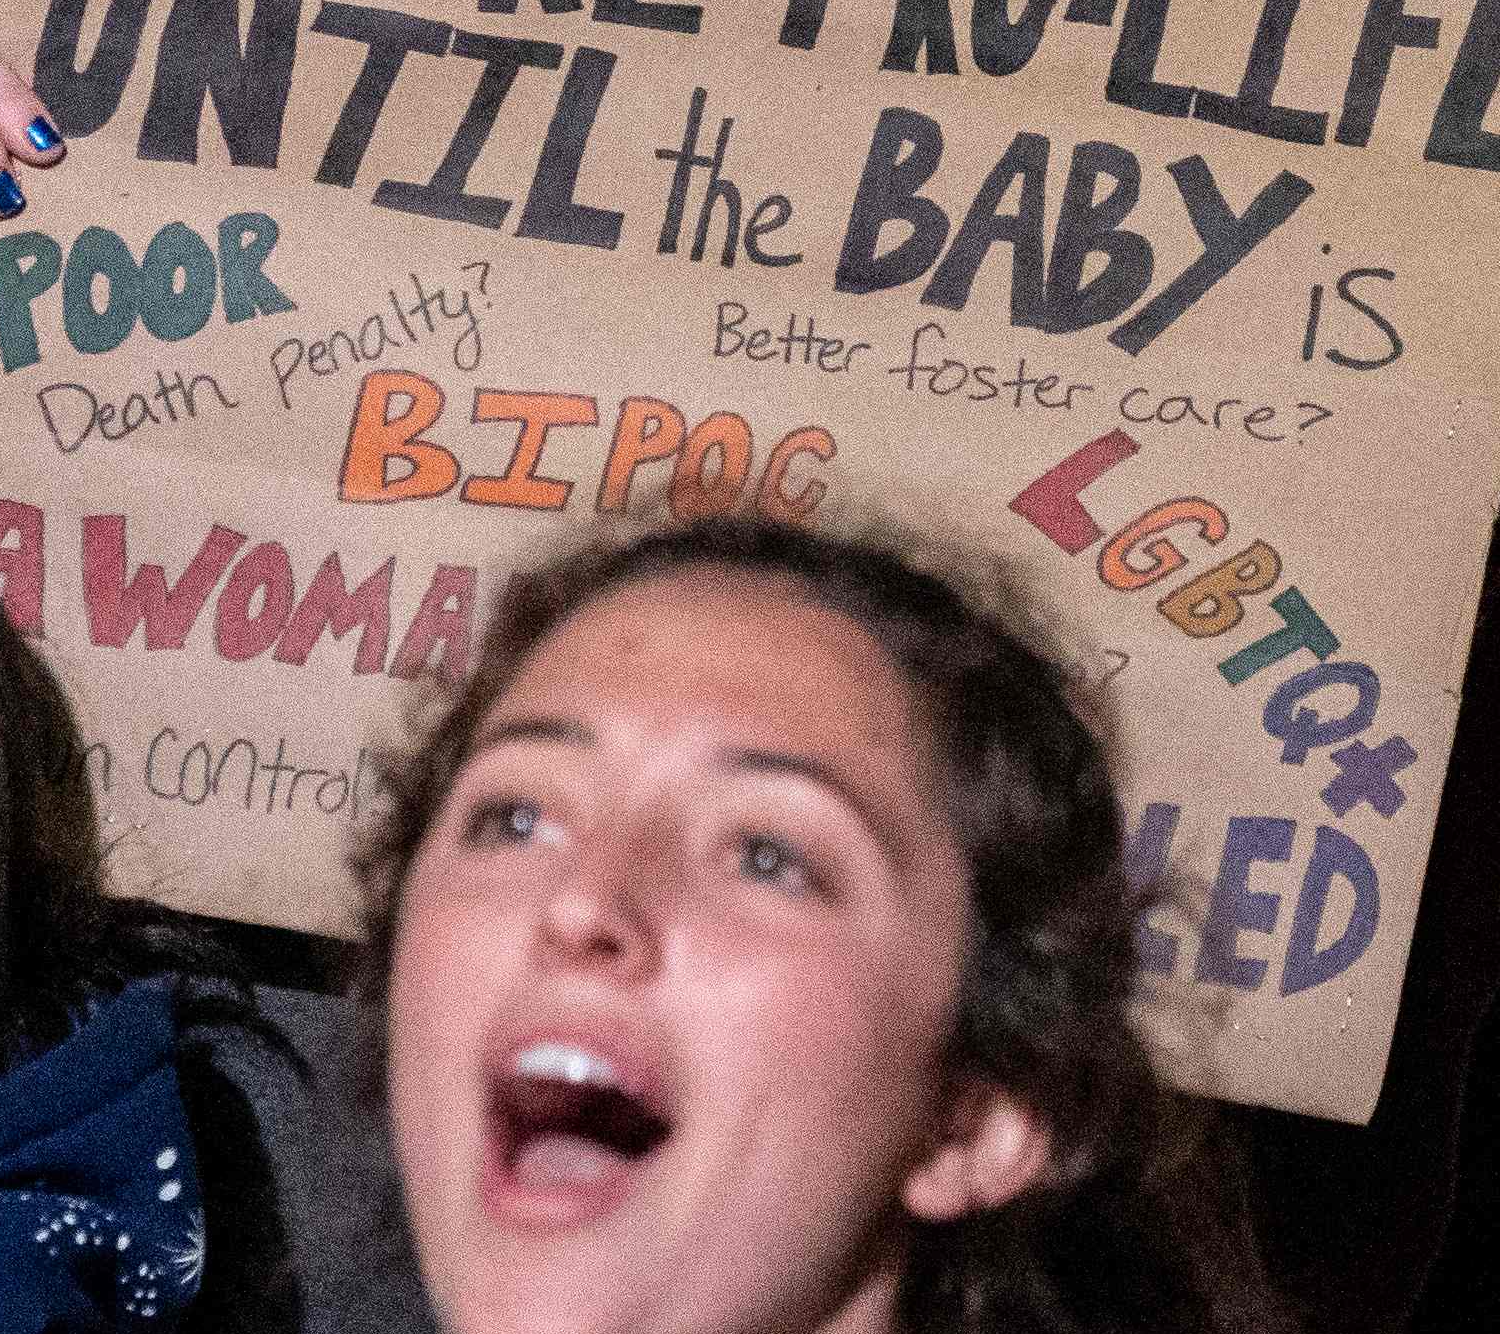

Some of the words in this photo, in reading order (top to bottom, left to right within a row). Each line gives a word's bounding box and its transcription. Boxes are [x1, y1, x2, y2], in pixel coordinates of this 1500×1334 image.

[656, 87, 804, 271] the
[835, 109, 1314, 354] BABY
[1302, 245, 1406, 372] is
[37, 371, 239, 454] Death
[339, 369, 838, 520] BIPOC
[713, 300, 870, 374] Better
[888, 325, 1094, 411] foster
[1120, 385, 1333, 445] care?
[82, 514, 540, 683] WOMA
